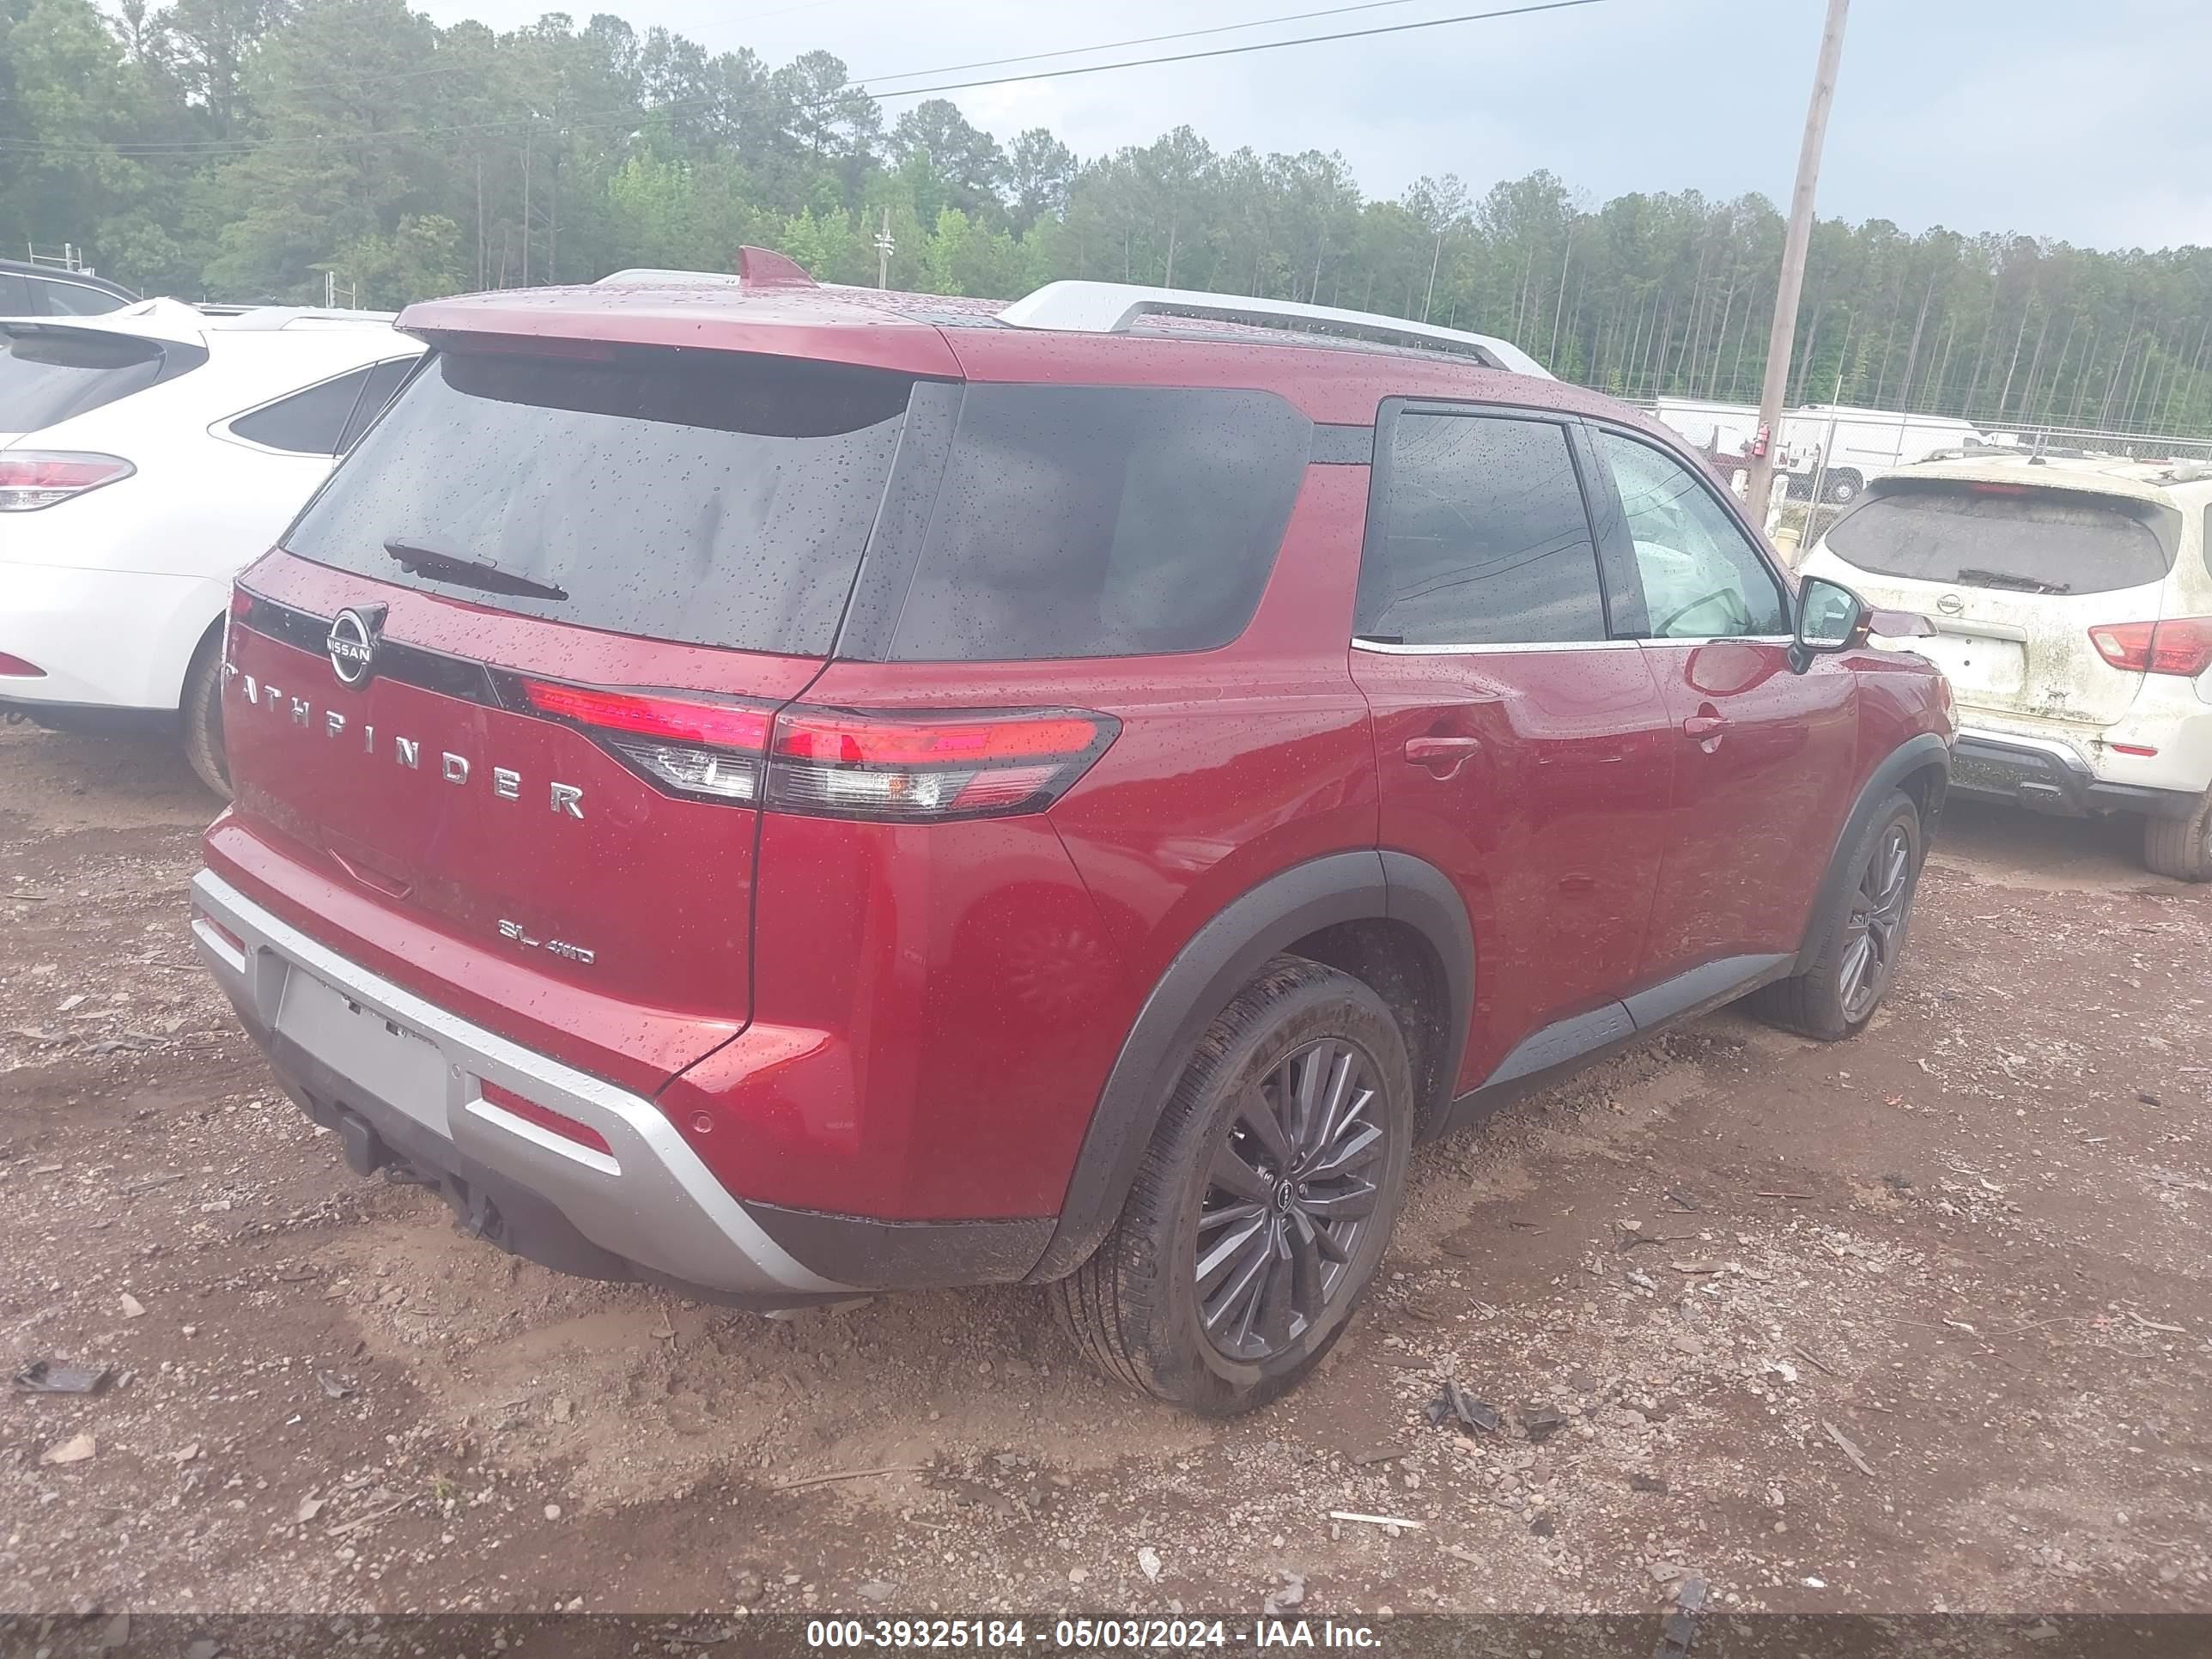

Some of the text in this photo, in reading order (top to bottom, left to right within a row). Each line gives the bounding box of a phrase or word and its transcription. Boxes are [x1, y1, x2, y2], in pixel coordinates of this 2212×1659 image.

[327, 638, 370, 662] NISSAN
[498, 918, 595, 965] SL 4WD
